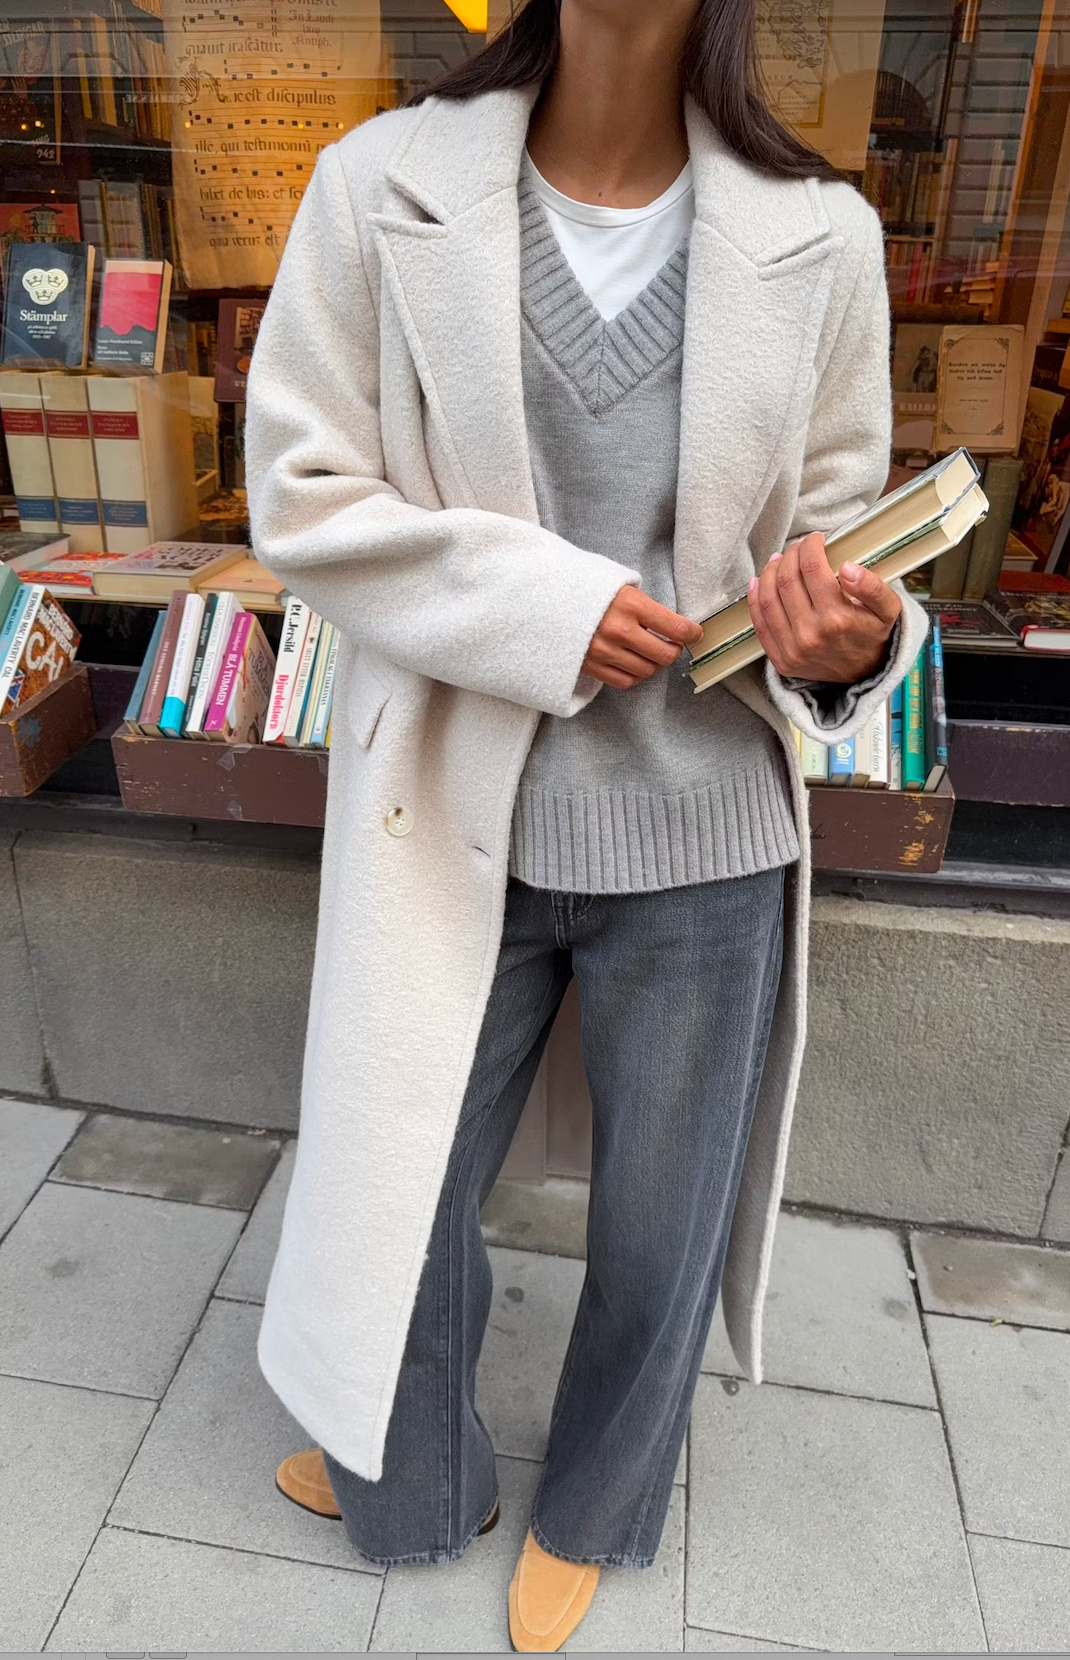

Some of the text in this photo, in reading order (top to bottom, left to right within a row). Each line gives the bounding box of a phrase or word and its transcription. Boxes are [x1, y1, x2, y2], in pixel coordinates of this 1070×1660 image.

[20, 309, 68, 325] Stämplar
[23, 592, 39, 621] BERNARD
[2, 666, 12, 678] CAL
[225, 653, 237, 670] BLÅ
[215, 669, 233, 706] TUMMEN
[269, 674, 289, 729] Djurdoktorn
